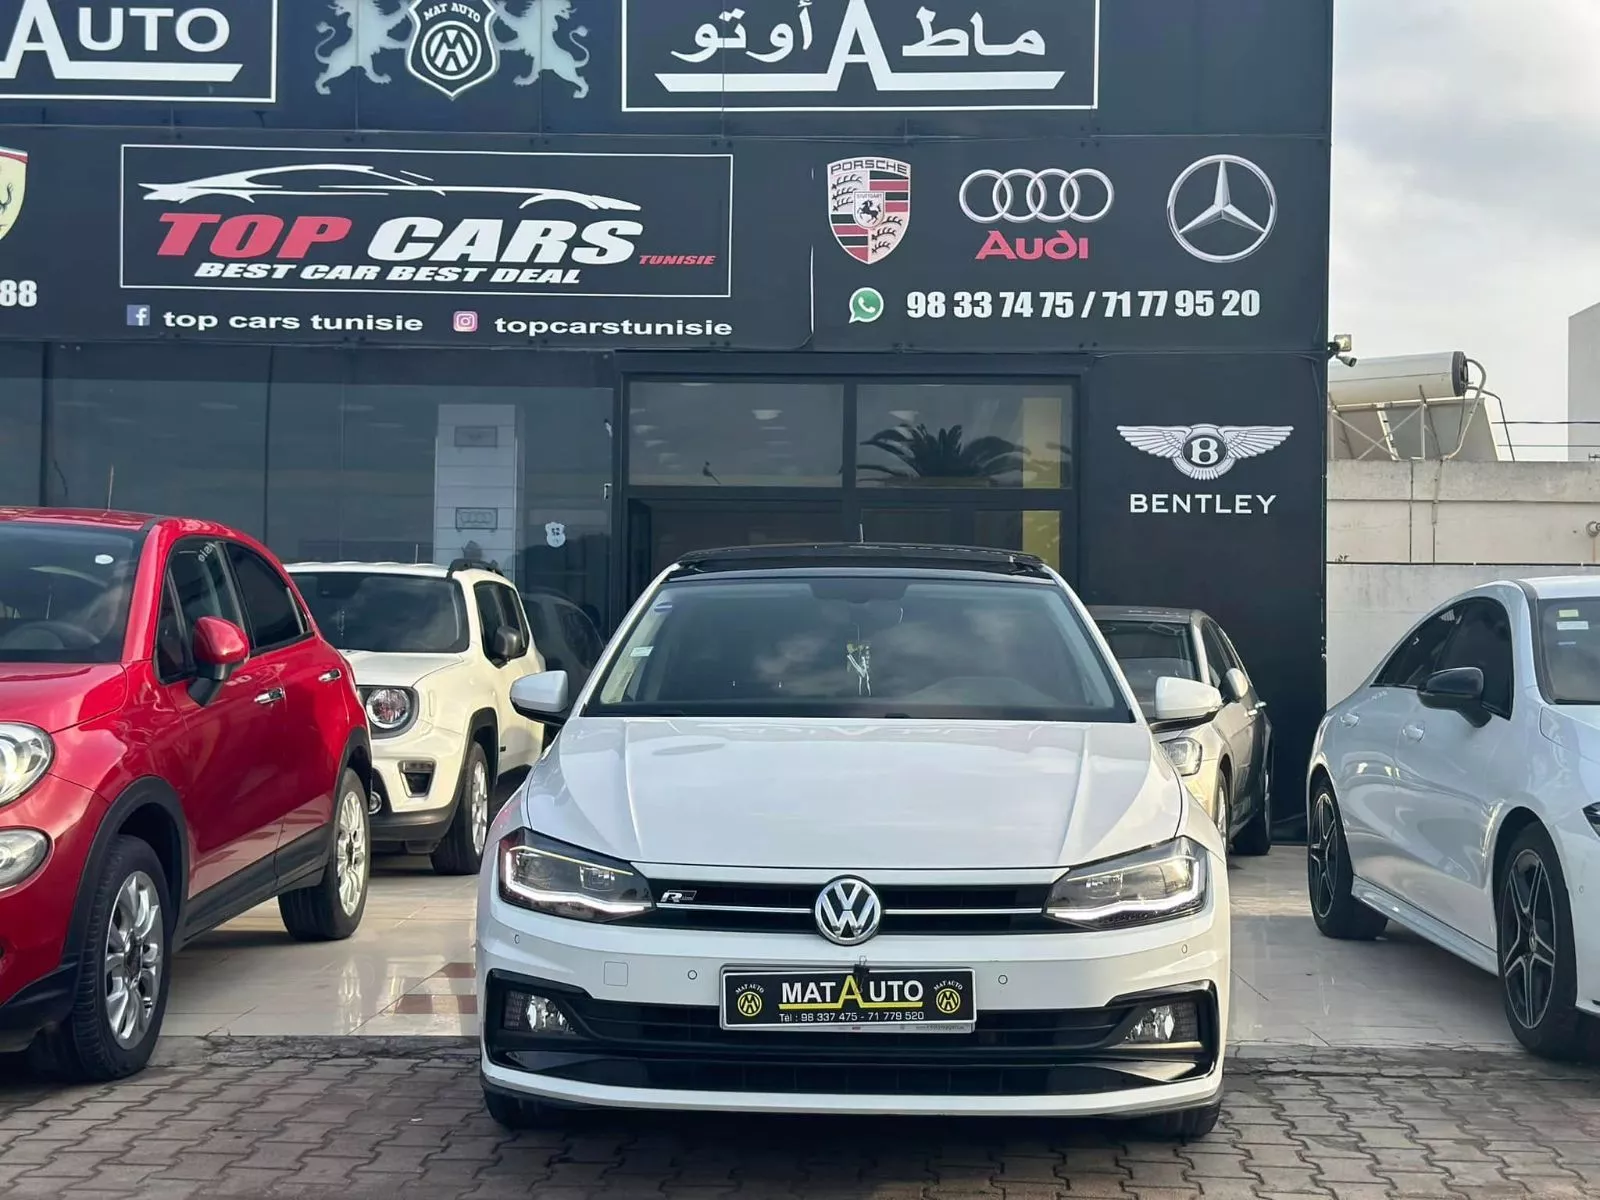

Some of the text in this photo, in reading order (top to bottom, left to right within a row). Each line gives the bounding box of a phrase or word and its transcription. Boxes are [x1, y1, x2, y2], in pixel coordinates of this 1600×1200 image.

[423, 2, 481, 23] MAT AUTO
[902, 5, 1046, 57] ماط
[830, 160, 908, 175] PORSCHE
[156, 212, 718, 266] TOP CARS TUNISIE
[975, 229, 1089, 260] Audi
[194, 262, 581, 284] BEST CAR BEST DEAL
[906, 289, 1261, 319] 98 33 74 75 / 71 77 95 20
[163, 311, 424, 331] top cars tunisie
[494, 317, 733, 337] topcarstunisie
[1129, 493, 1277, 514] BENTLEY
[801, 1013, 814, 1021] 98
[817, 1013, 836, 1021] 337
[839, 1012, 858, 1021] 475
[868, 1012, 879, 1020] 71
[905, 1011, 924, 1020] 520
